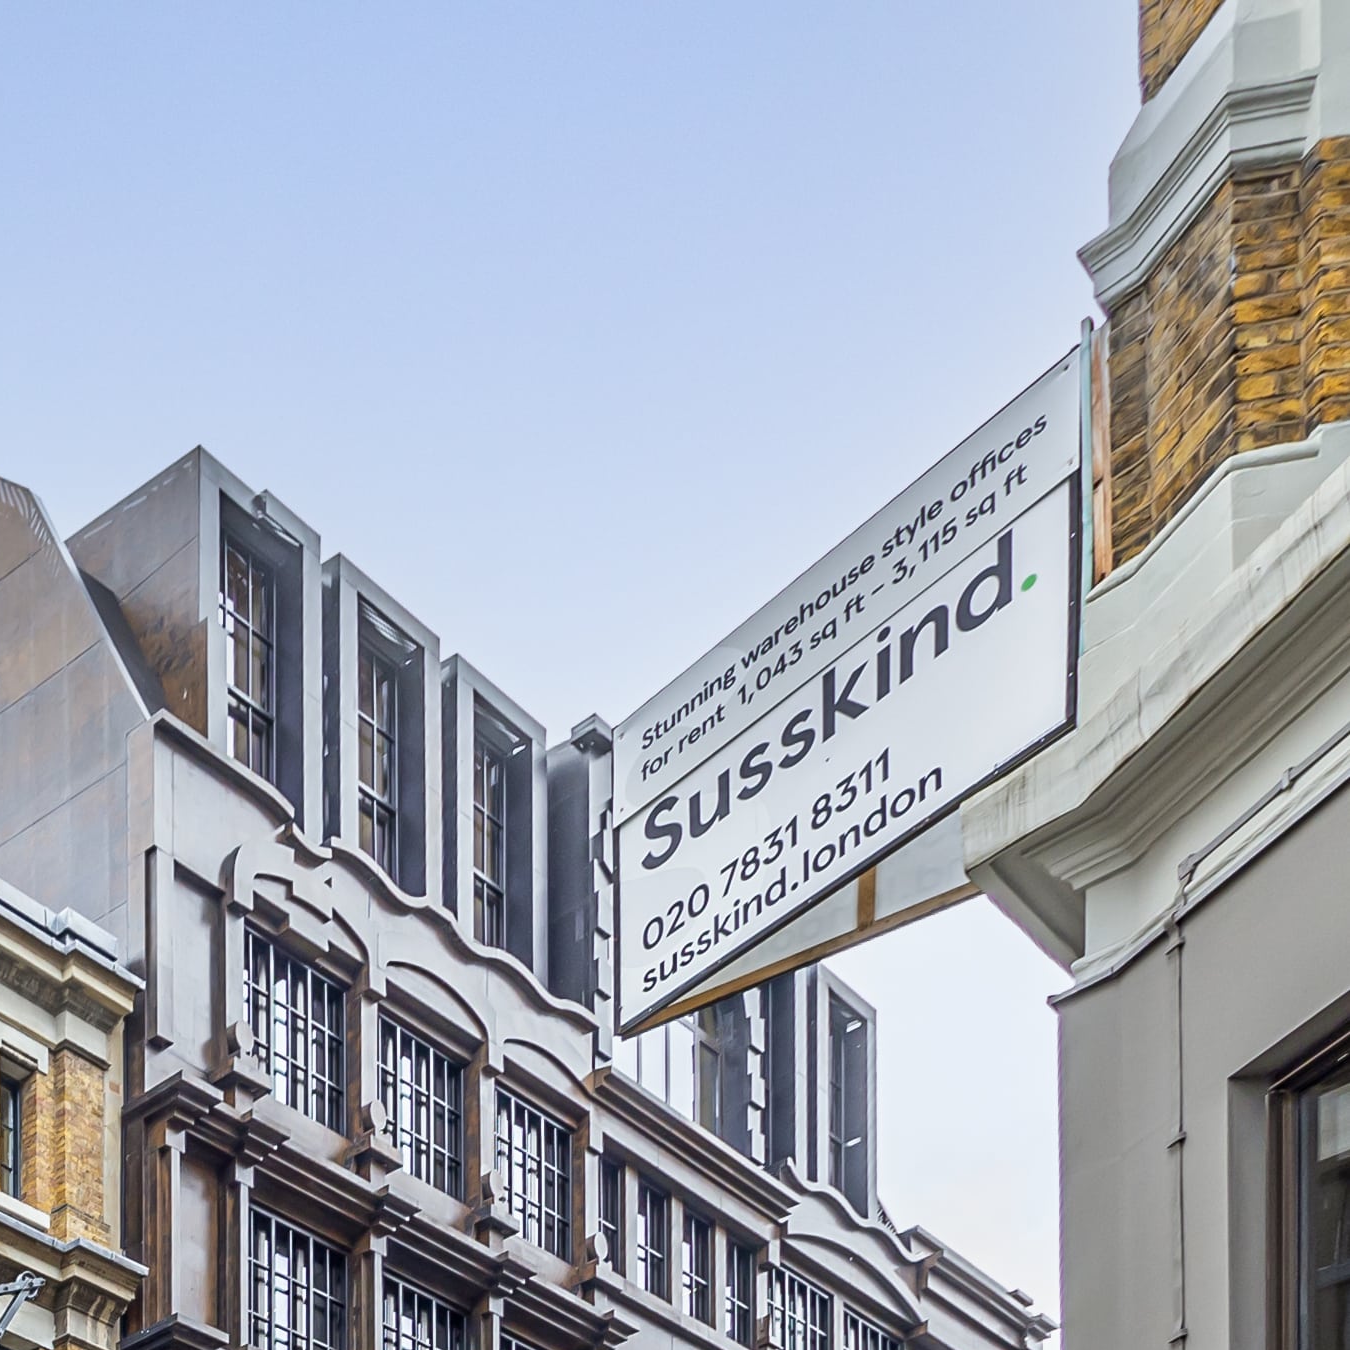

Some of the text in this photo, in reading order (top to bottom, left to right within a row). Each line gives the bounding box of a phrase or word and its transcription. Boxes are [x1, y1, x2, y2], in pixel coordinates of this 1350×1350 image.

[641, 747, 673, 782] for
[678, 703, 726, 754] rent
[737, 640, 804, 706] 1,043
[809, 617, 837, 651] sq
[843, 593, 865, 623] ft
[964, 491, 996, 527] sq
[1003, 463, 1028, 496] ft
[642, 414, 1048, 751] Stunning warehouse style offices
[643, 747, 890, 950] 020 7831 8311
[643, 767, 943, 992] susskind.london
